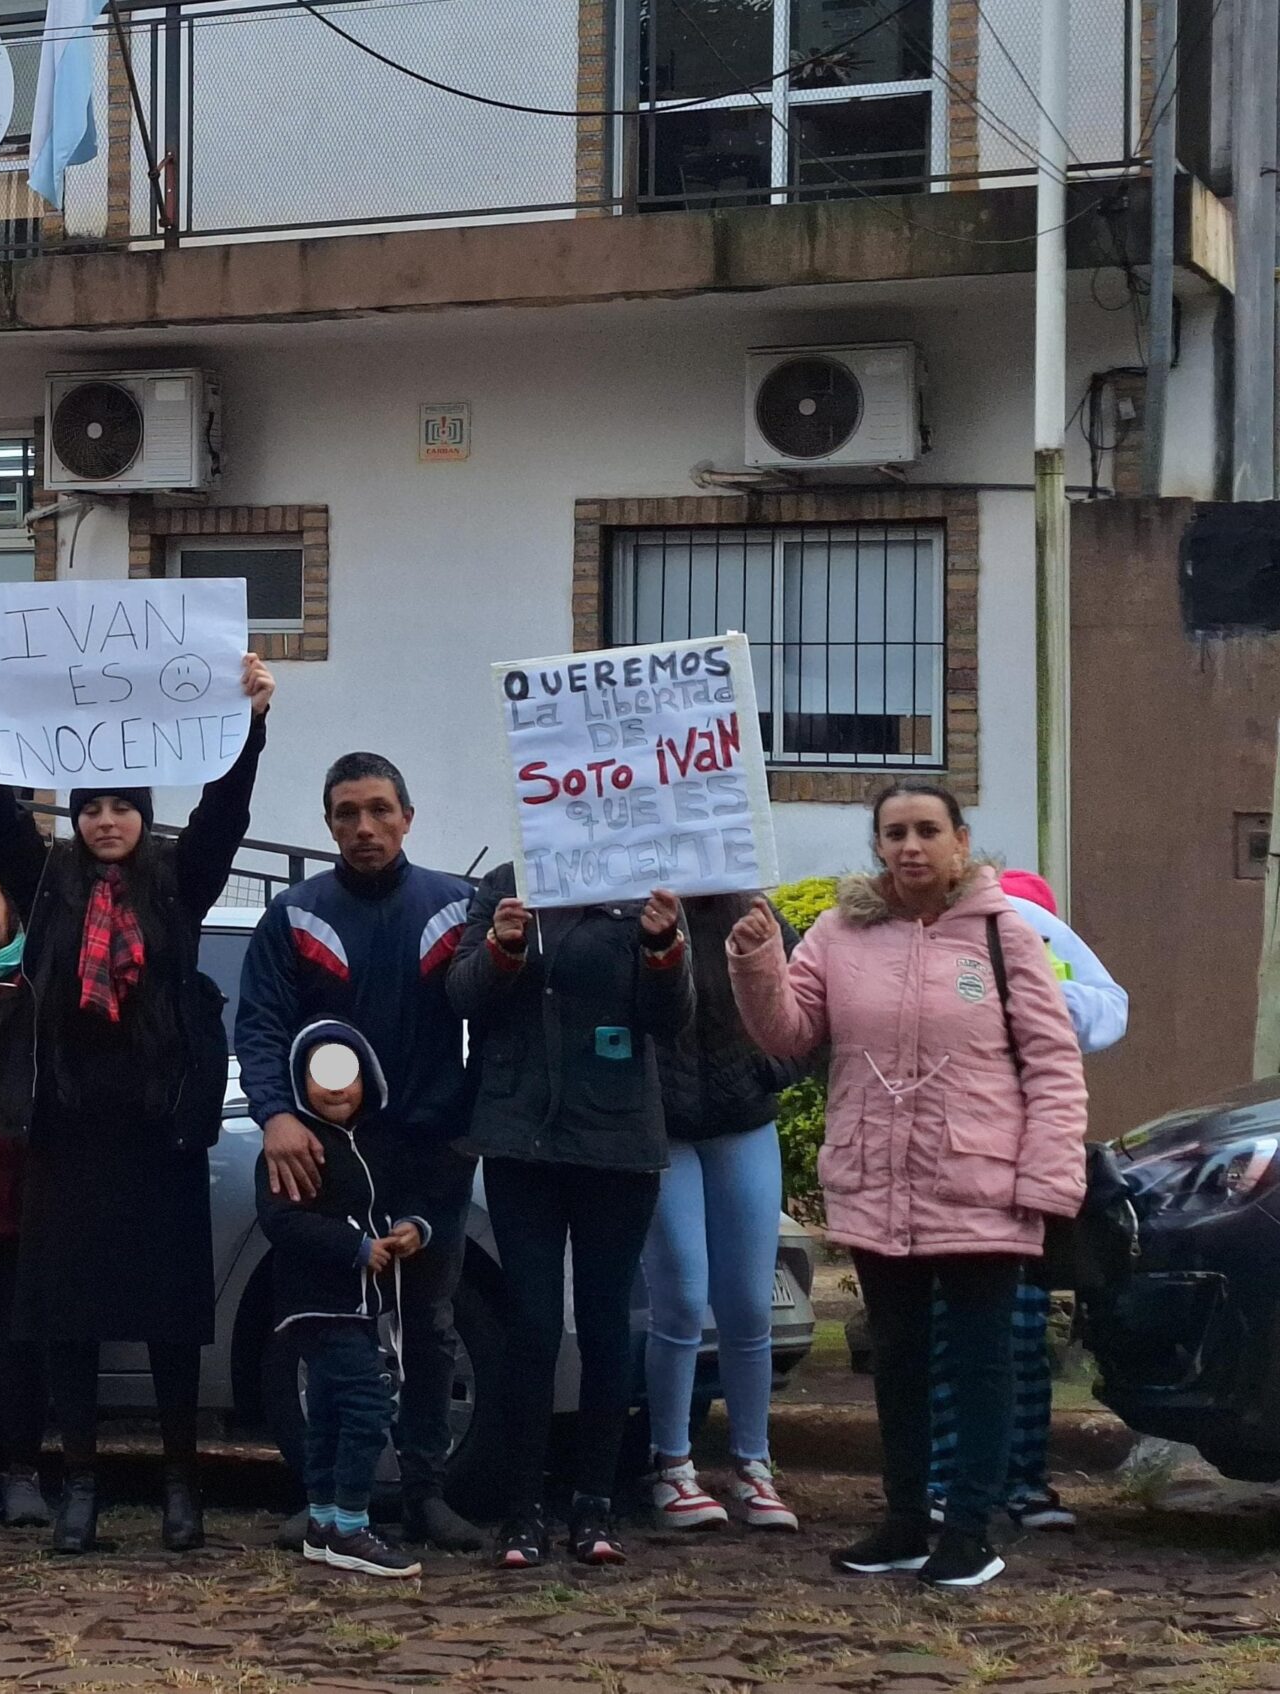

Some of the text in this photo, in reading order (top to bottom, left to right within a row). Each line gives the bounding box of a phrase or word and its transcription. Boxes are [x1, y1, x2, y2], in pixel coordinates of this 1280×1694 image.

[0, 594, 186, 661] IVAN
[69, 662, 133, 705] ES
[504, 646, 732, 701] QUEREMOS
[587, 718, 649, 753] DE
[673, 775, 749, 823] ES
[524, 827, 759, 899] INOCENTE
